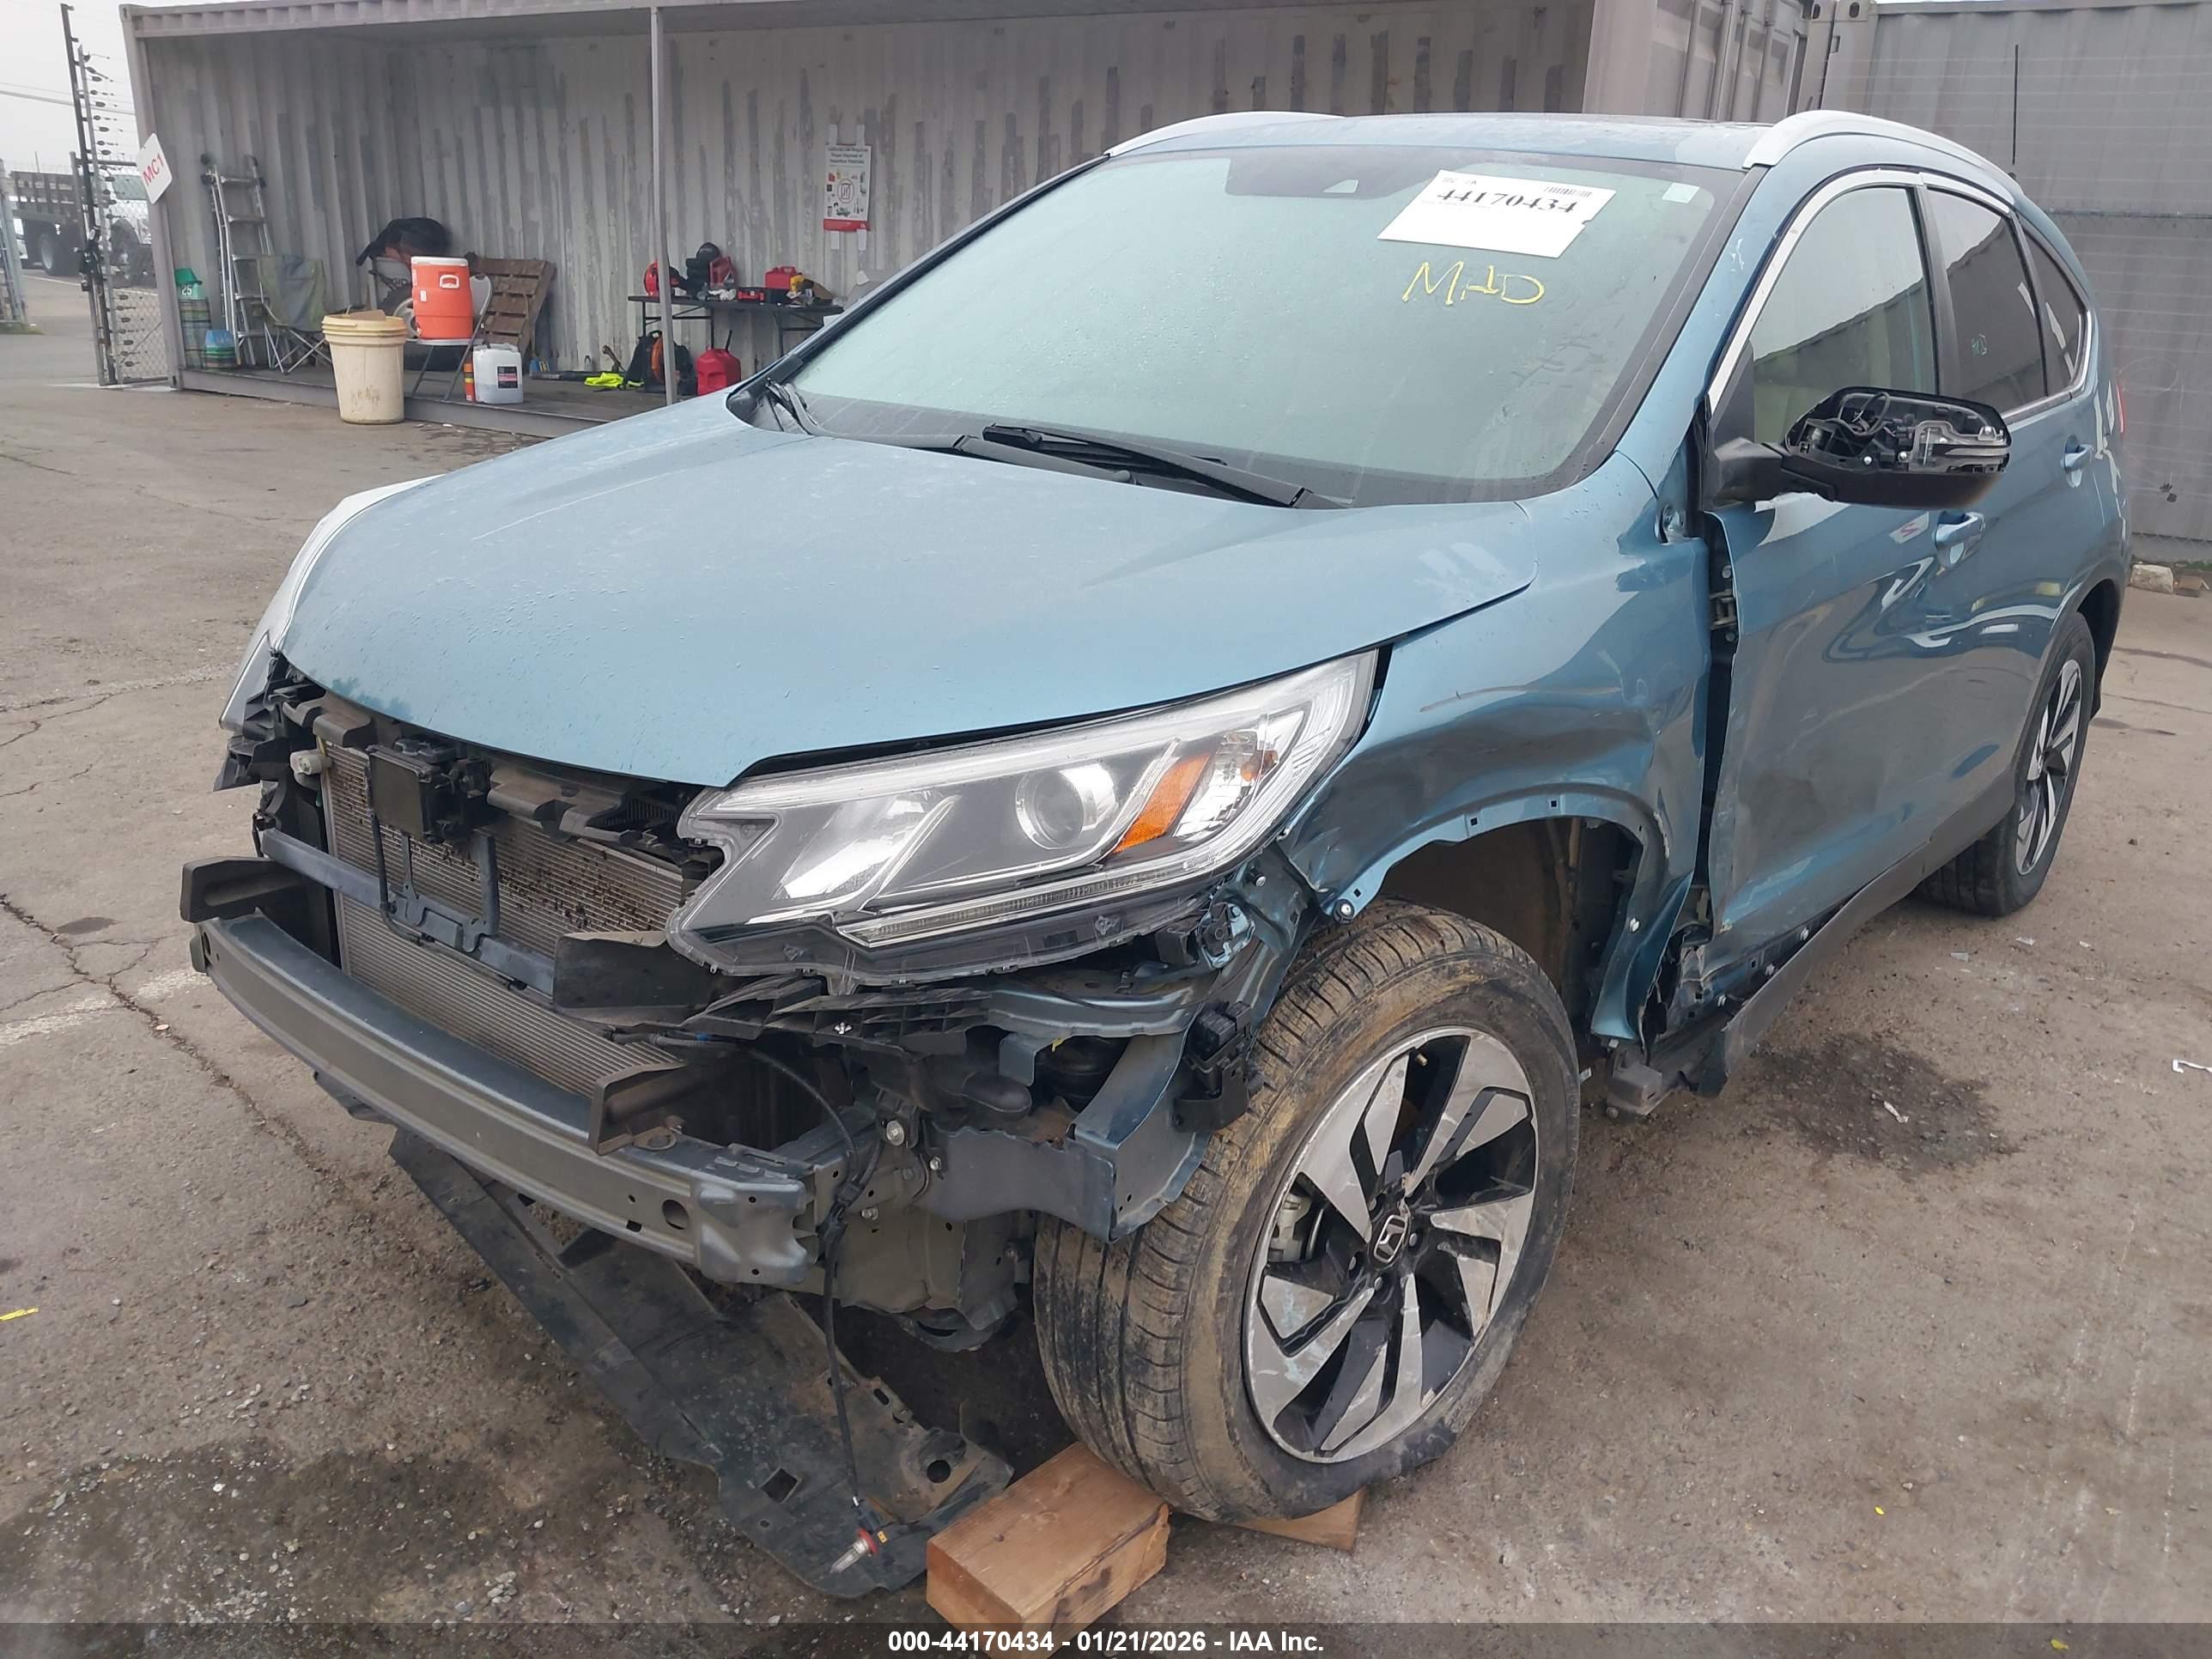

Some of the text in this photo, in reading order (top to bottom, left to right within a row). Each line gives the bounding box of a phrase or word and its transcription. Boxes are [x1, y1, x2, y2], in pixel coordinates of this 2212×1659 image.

[143, 153, 164, 186] MC1
[1437, 189, 1578, 213] 44170434
[181, 283, 192, 296] 25
